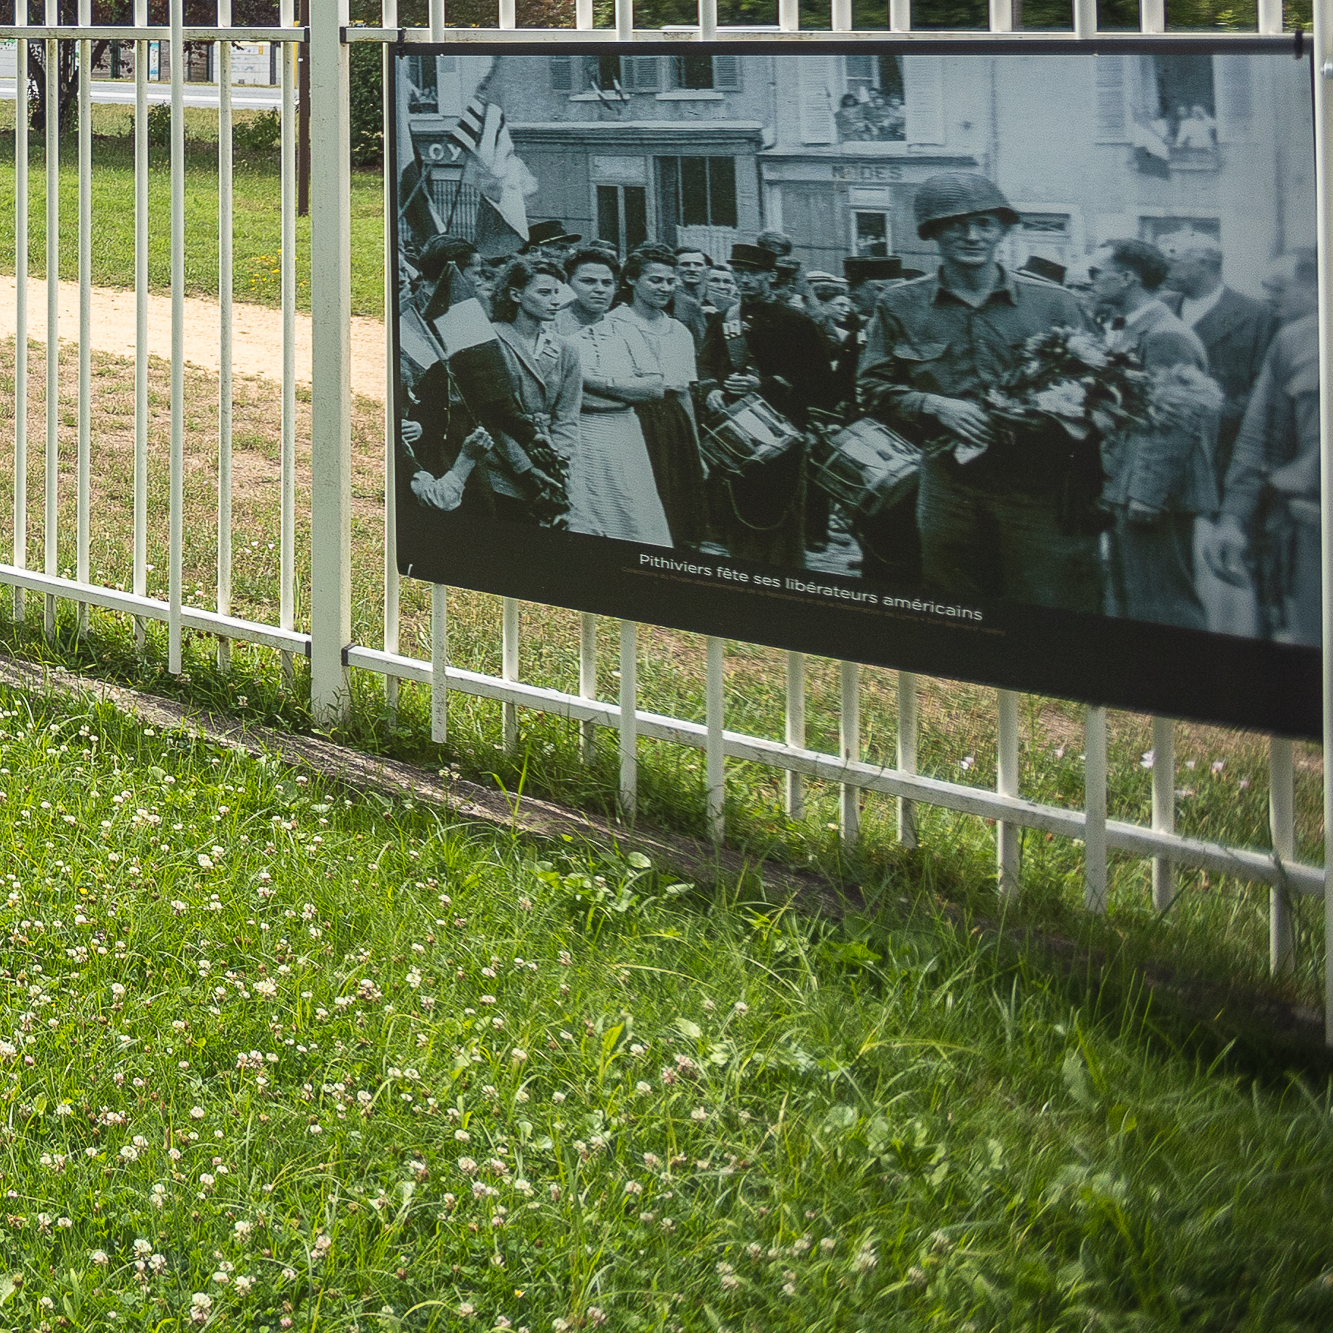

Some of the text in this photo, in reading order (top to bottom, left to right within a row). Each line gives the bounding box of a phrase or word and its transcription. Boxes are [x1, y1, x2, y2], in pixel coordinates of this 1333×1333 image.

[638, 553, 713, 577] Pithiviers
[716, 566, 750, 583] fête
[753, 573, 781, 588] ses
[784, 577, 879, 605] libérateurs
[882, 595, 983, 622] américains
